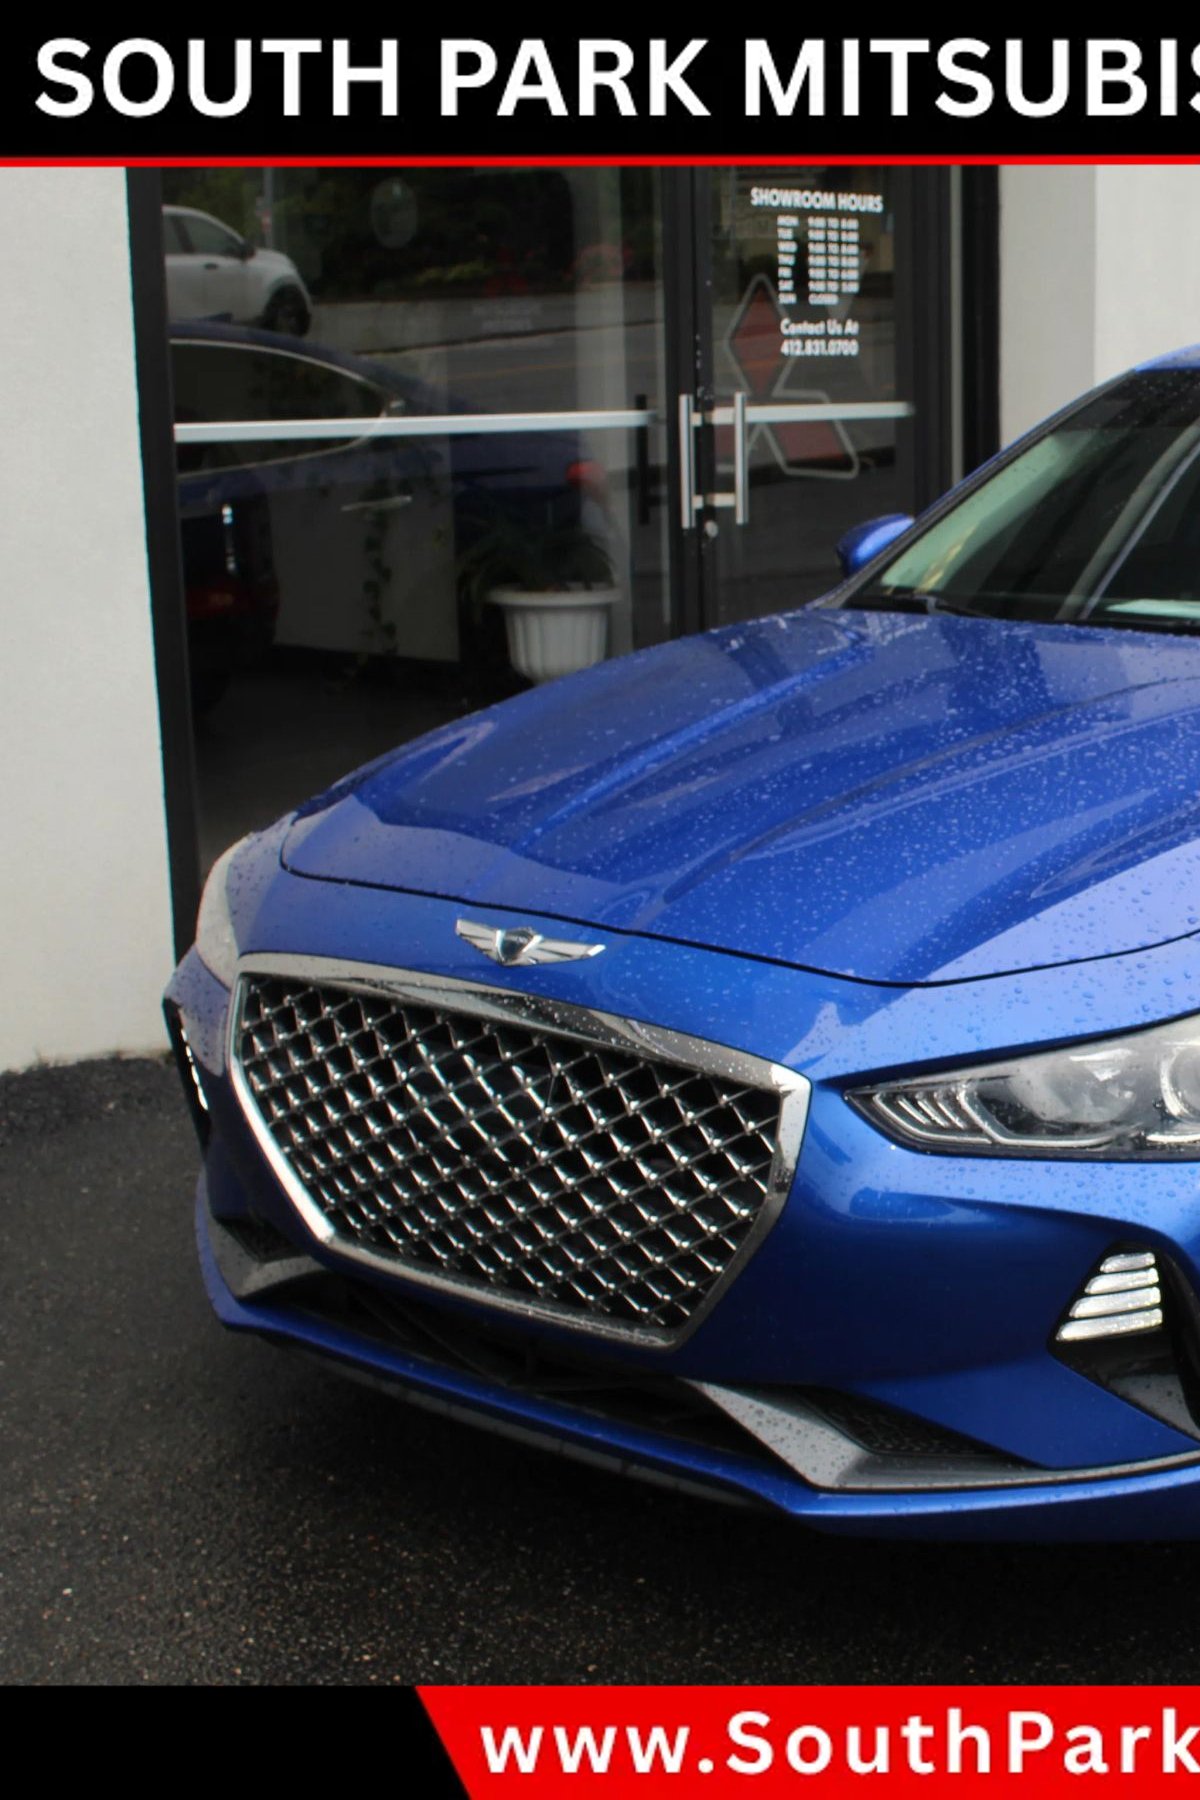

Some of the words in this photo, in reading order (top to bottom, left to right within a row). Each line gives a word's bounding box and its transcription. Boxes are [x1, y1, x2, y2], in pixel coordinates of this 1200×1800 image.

[750, 187, 836, 209] SHOWROOM
[837, 193, 884, 213] HOURS
[780, 317, 825, 335] Contact
[826, 319, 842, 335] Us
[844, 319, 859, 335] At
[780, 339, 859, 356] 412.831.0700
